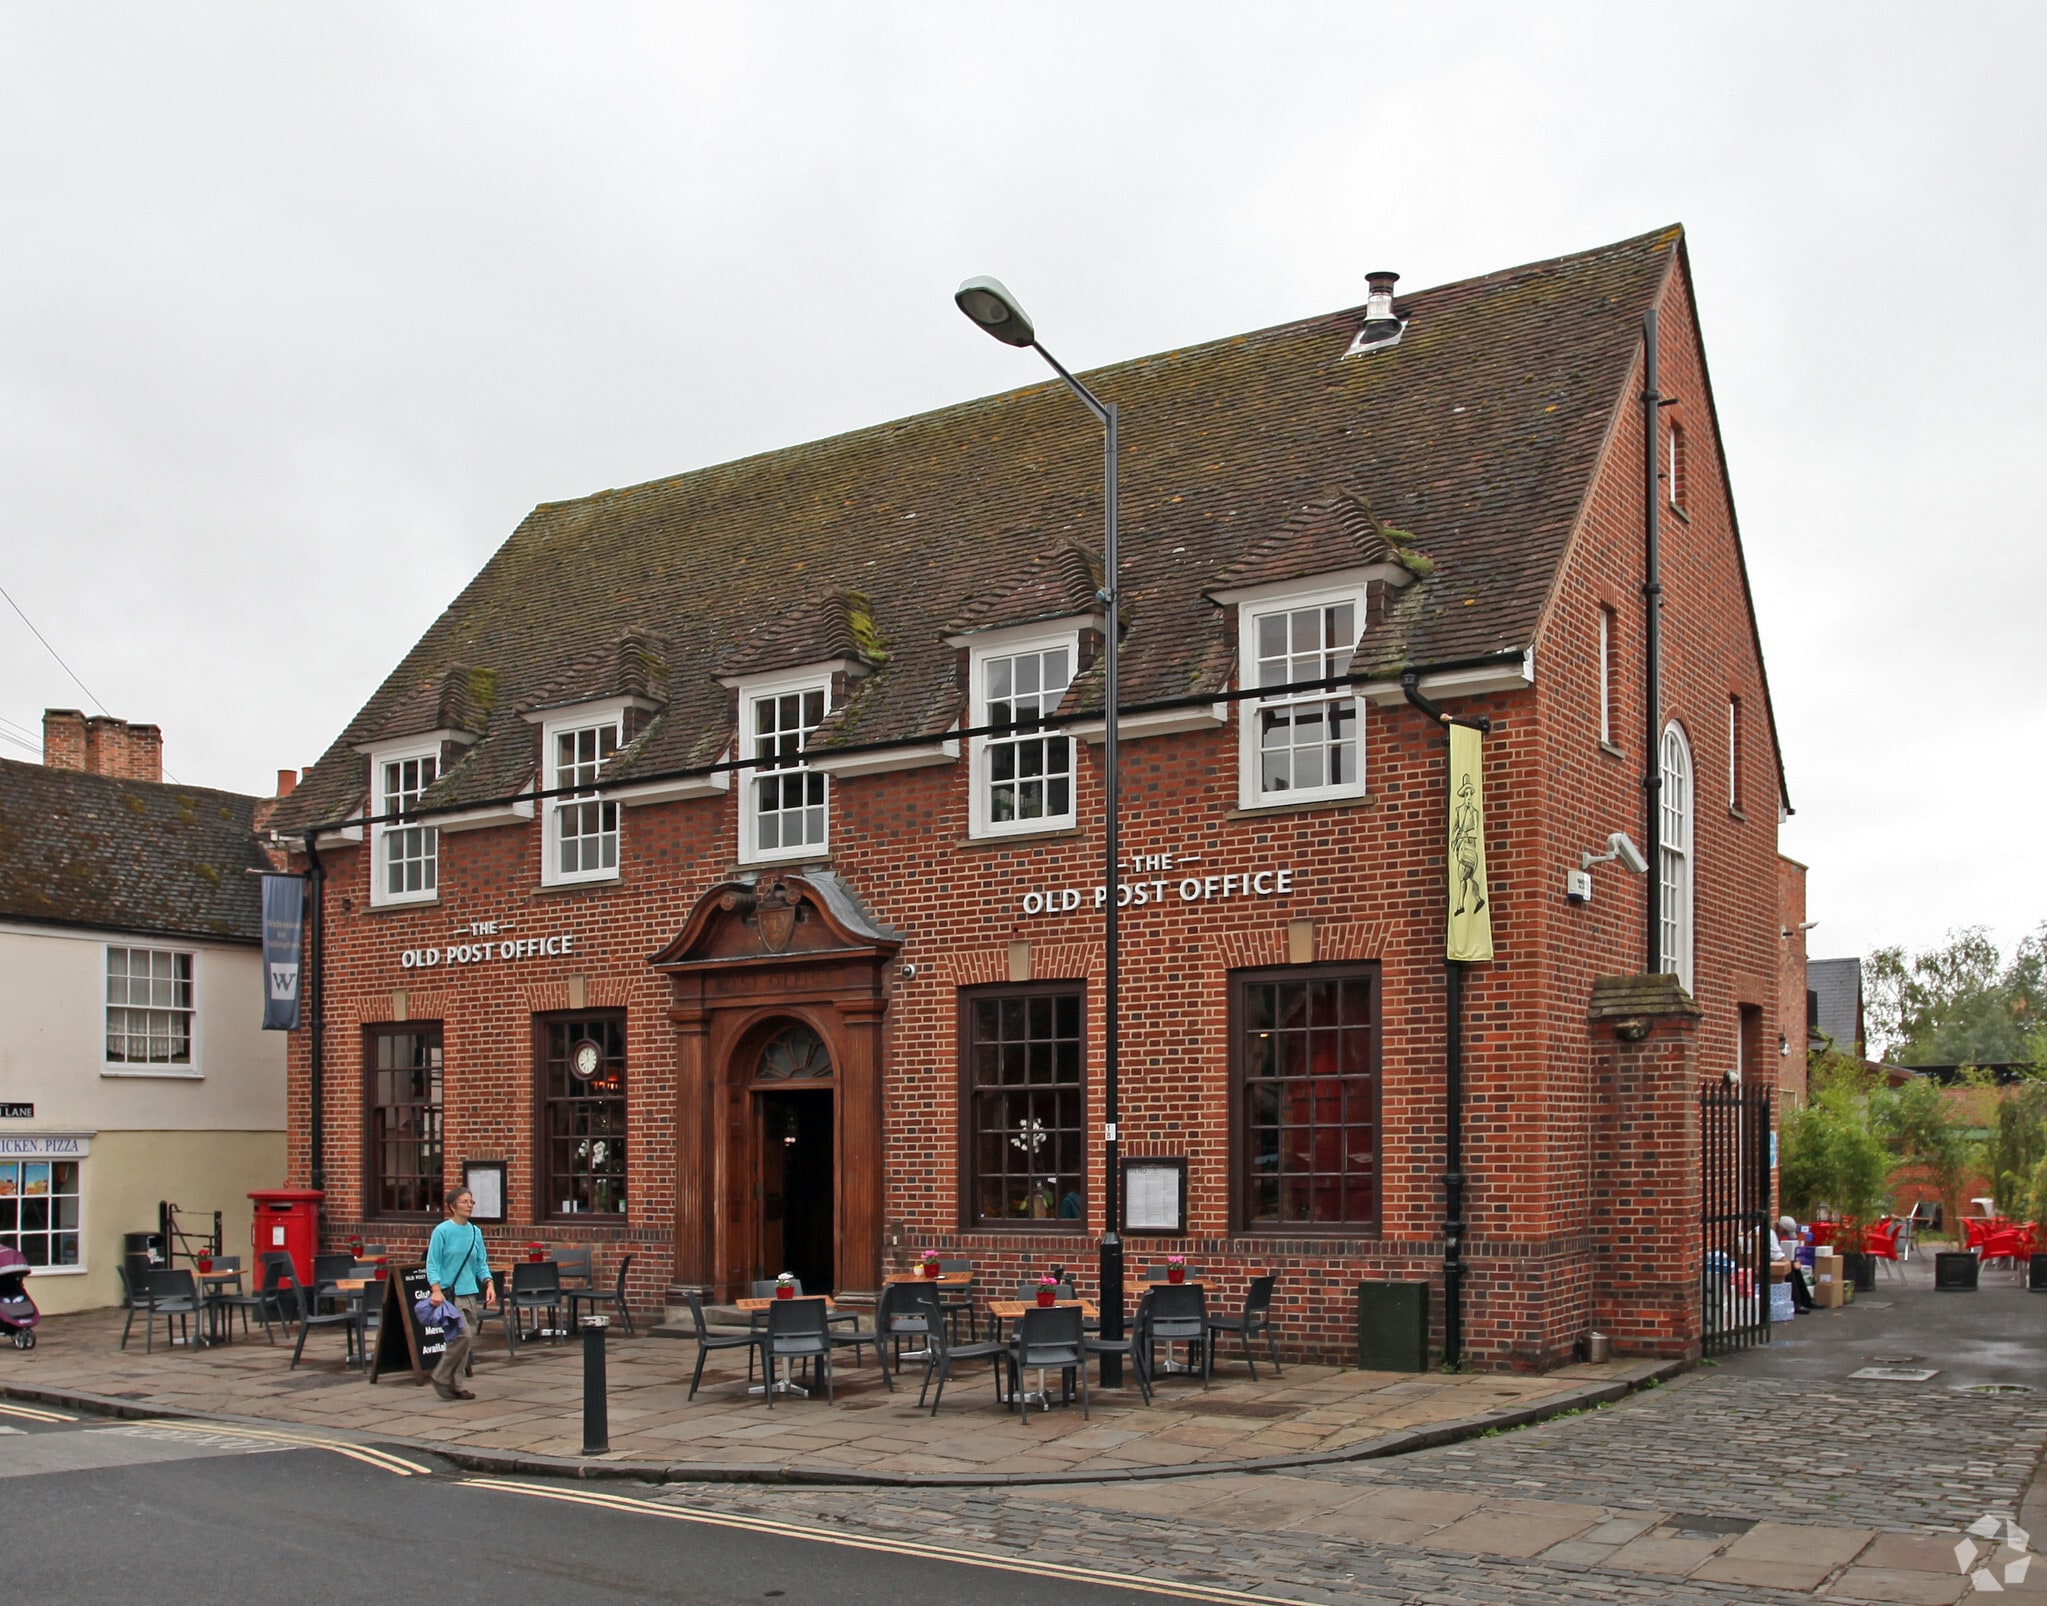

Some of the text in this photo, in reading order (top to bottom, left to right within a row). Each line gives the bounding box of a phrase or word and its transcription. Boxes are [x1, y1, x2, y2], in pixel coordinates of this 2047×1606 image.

[1131, 854, 1173, 872] THE
[1023, 888, 1081, 914] OLD
[1179, 869, 1293, 901] OFFICE
[470, 921, 498, 936] THE
[401, 935, 574, 968] OLD POST OFFICE
[272, 972, 296, 992] W
[5, 1107, 32, 1117] LANE
[45, 1139, 79, 1152] PIZZA
